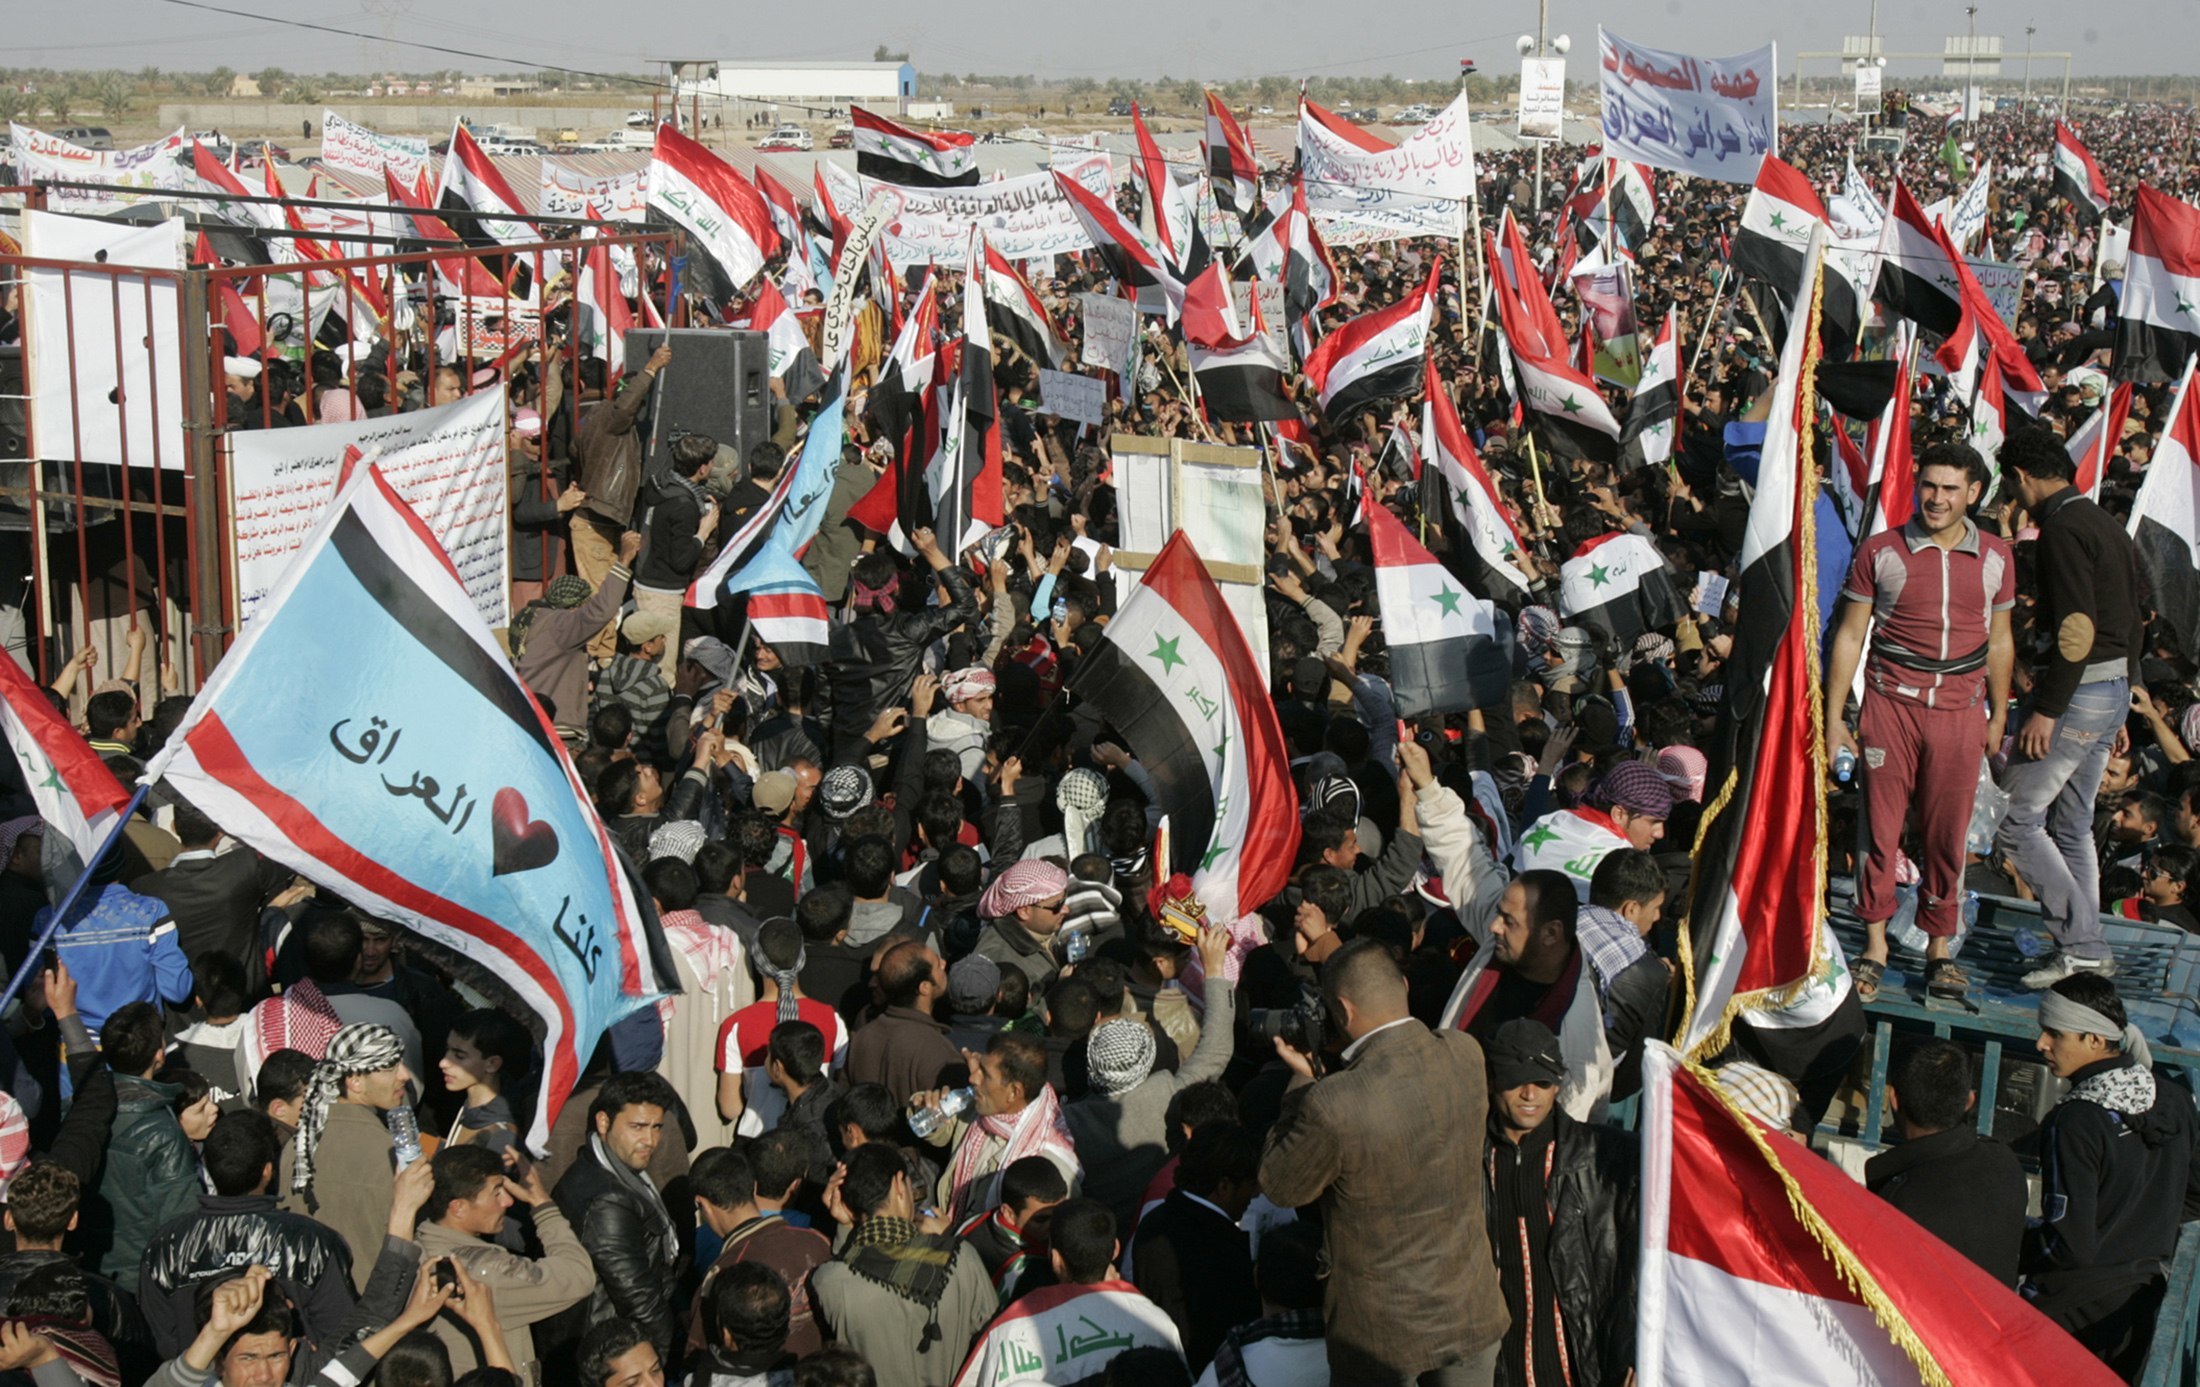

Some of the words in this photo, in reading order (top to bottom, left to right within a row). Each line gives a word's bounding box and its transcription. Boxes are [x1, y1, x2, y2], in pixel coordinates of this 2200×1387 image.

[1603, 44, 1701, 94] الصمود
[1705, 60, 1760, 106] جمعة
[1603, 89, 1677, 146] العراق
[1684, 106, 1741, 162] حرائر
[1423, 142, 1463, 177] نطالب
[658, 190, 697, 217] اكبر
[960, 193, 1004, 219] العراقية
[696, 216, 723, 239] الله
[852, 216, 877, 252] شلون
[828, 283, 848, 329] وجدي
[1362, 338, 1403, 371] اكبر
[1408, 324, 1424, 349] الله
[1528, 386, 1547, 401] الله
[329, 715, 477, 835] العراق
[553, 894, 603, 985] كلنا
